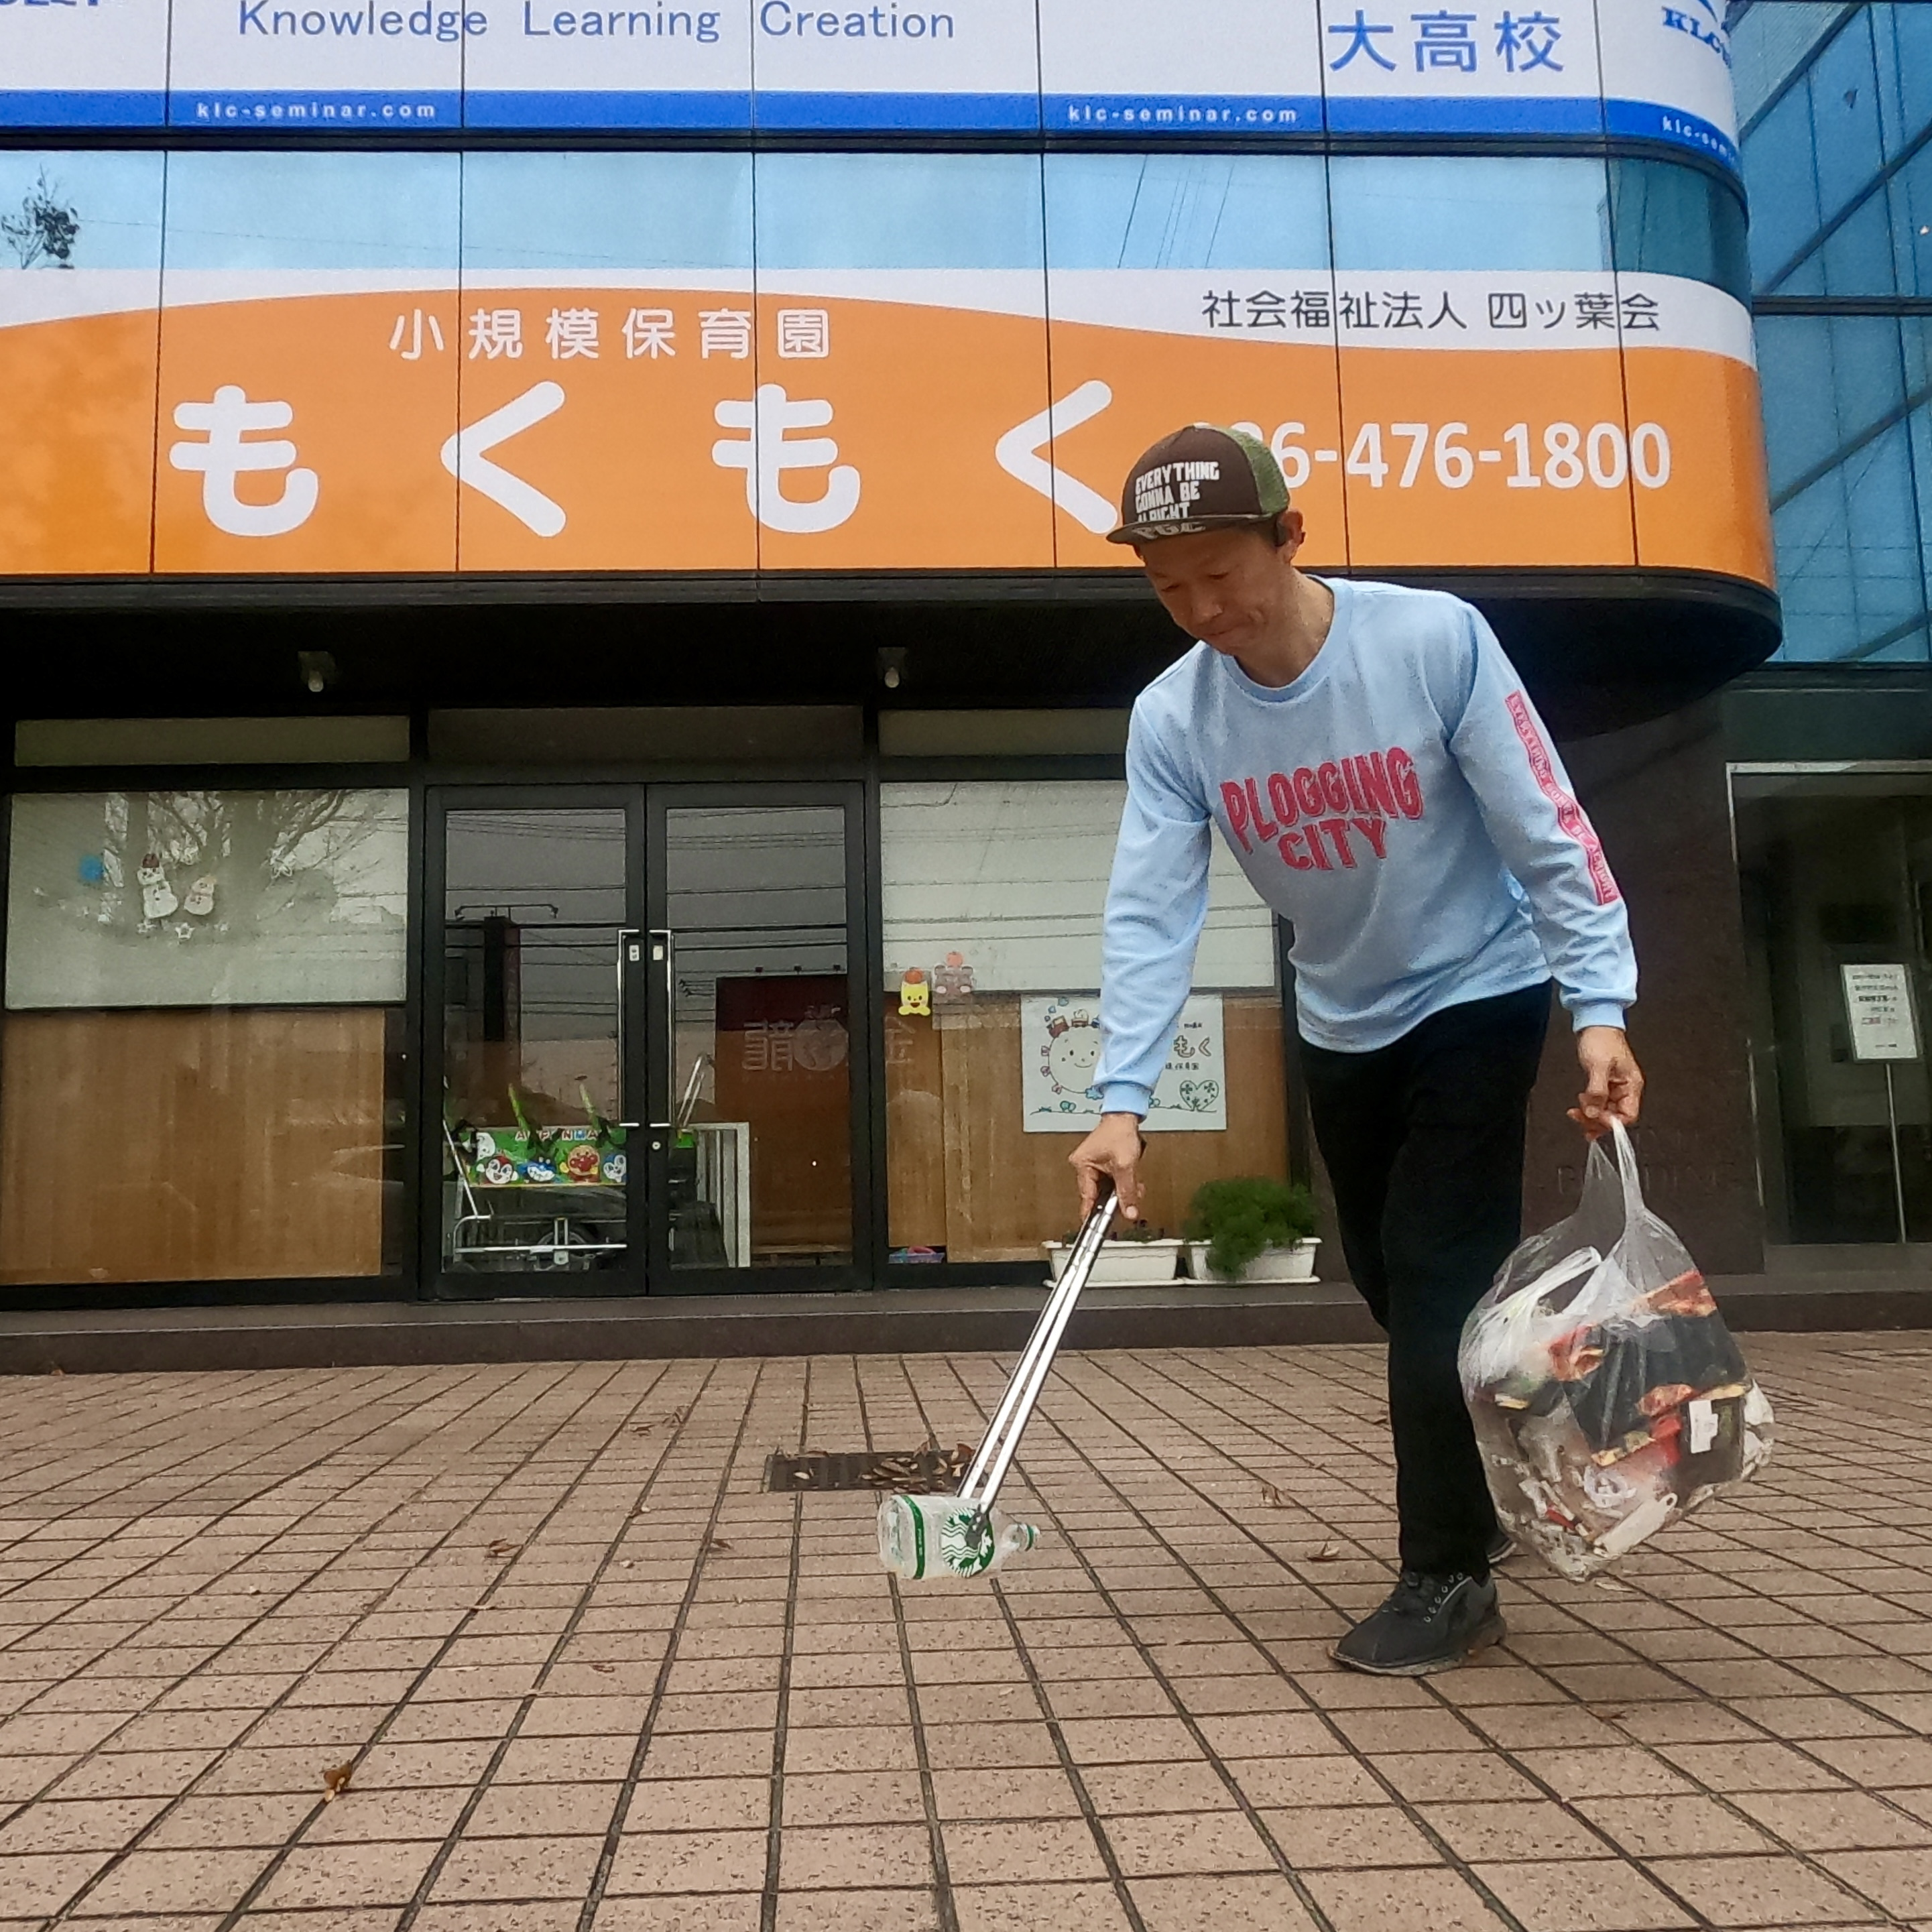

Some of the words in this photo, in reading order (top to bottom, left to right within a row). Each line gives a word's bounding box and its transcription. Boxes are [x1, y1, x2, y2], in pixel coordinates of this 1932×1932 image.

[239, 0, 488, 42] Knowledge
[524, 0, 721, 43] Learning
[760, 0, 955, 39] Creation
[1327, 9, 1565, 72] 大高校
[196, 103, 436, 118] klc-seminar.com
[1069, 105, 1297, 123] klc-seminar.com
[389, 308, 831, 360] 小規模保育園
[1201, 290, 1467, 330] 社会福祉法人
[1488, 292, 1661, 331] 四ツ葉会
[169, 379, 1118, 536] もくもく
[1135, 461, 1220, 495] EVERYTHING
[1195, 421, 1671, 489] 6-476-1800
[1135, 485, 1174, 514] GONNA
[1179, 480, 1201, 501] BE
[1219, 746, 1424, 855] PLOGGING
[1277, 817, 1387, 871] CITY
